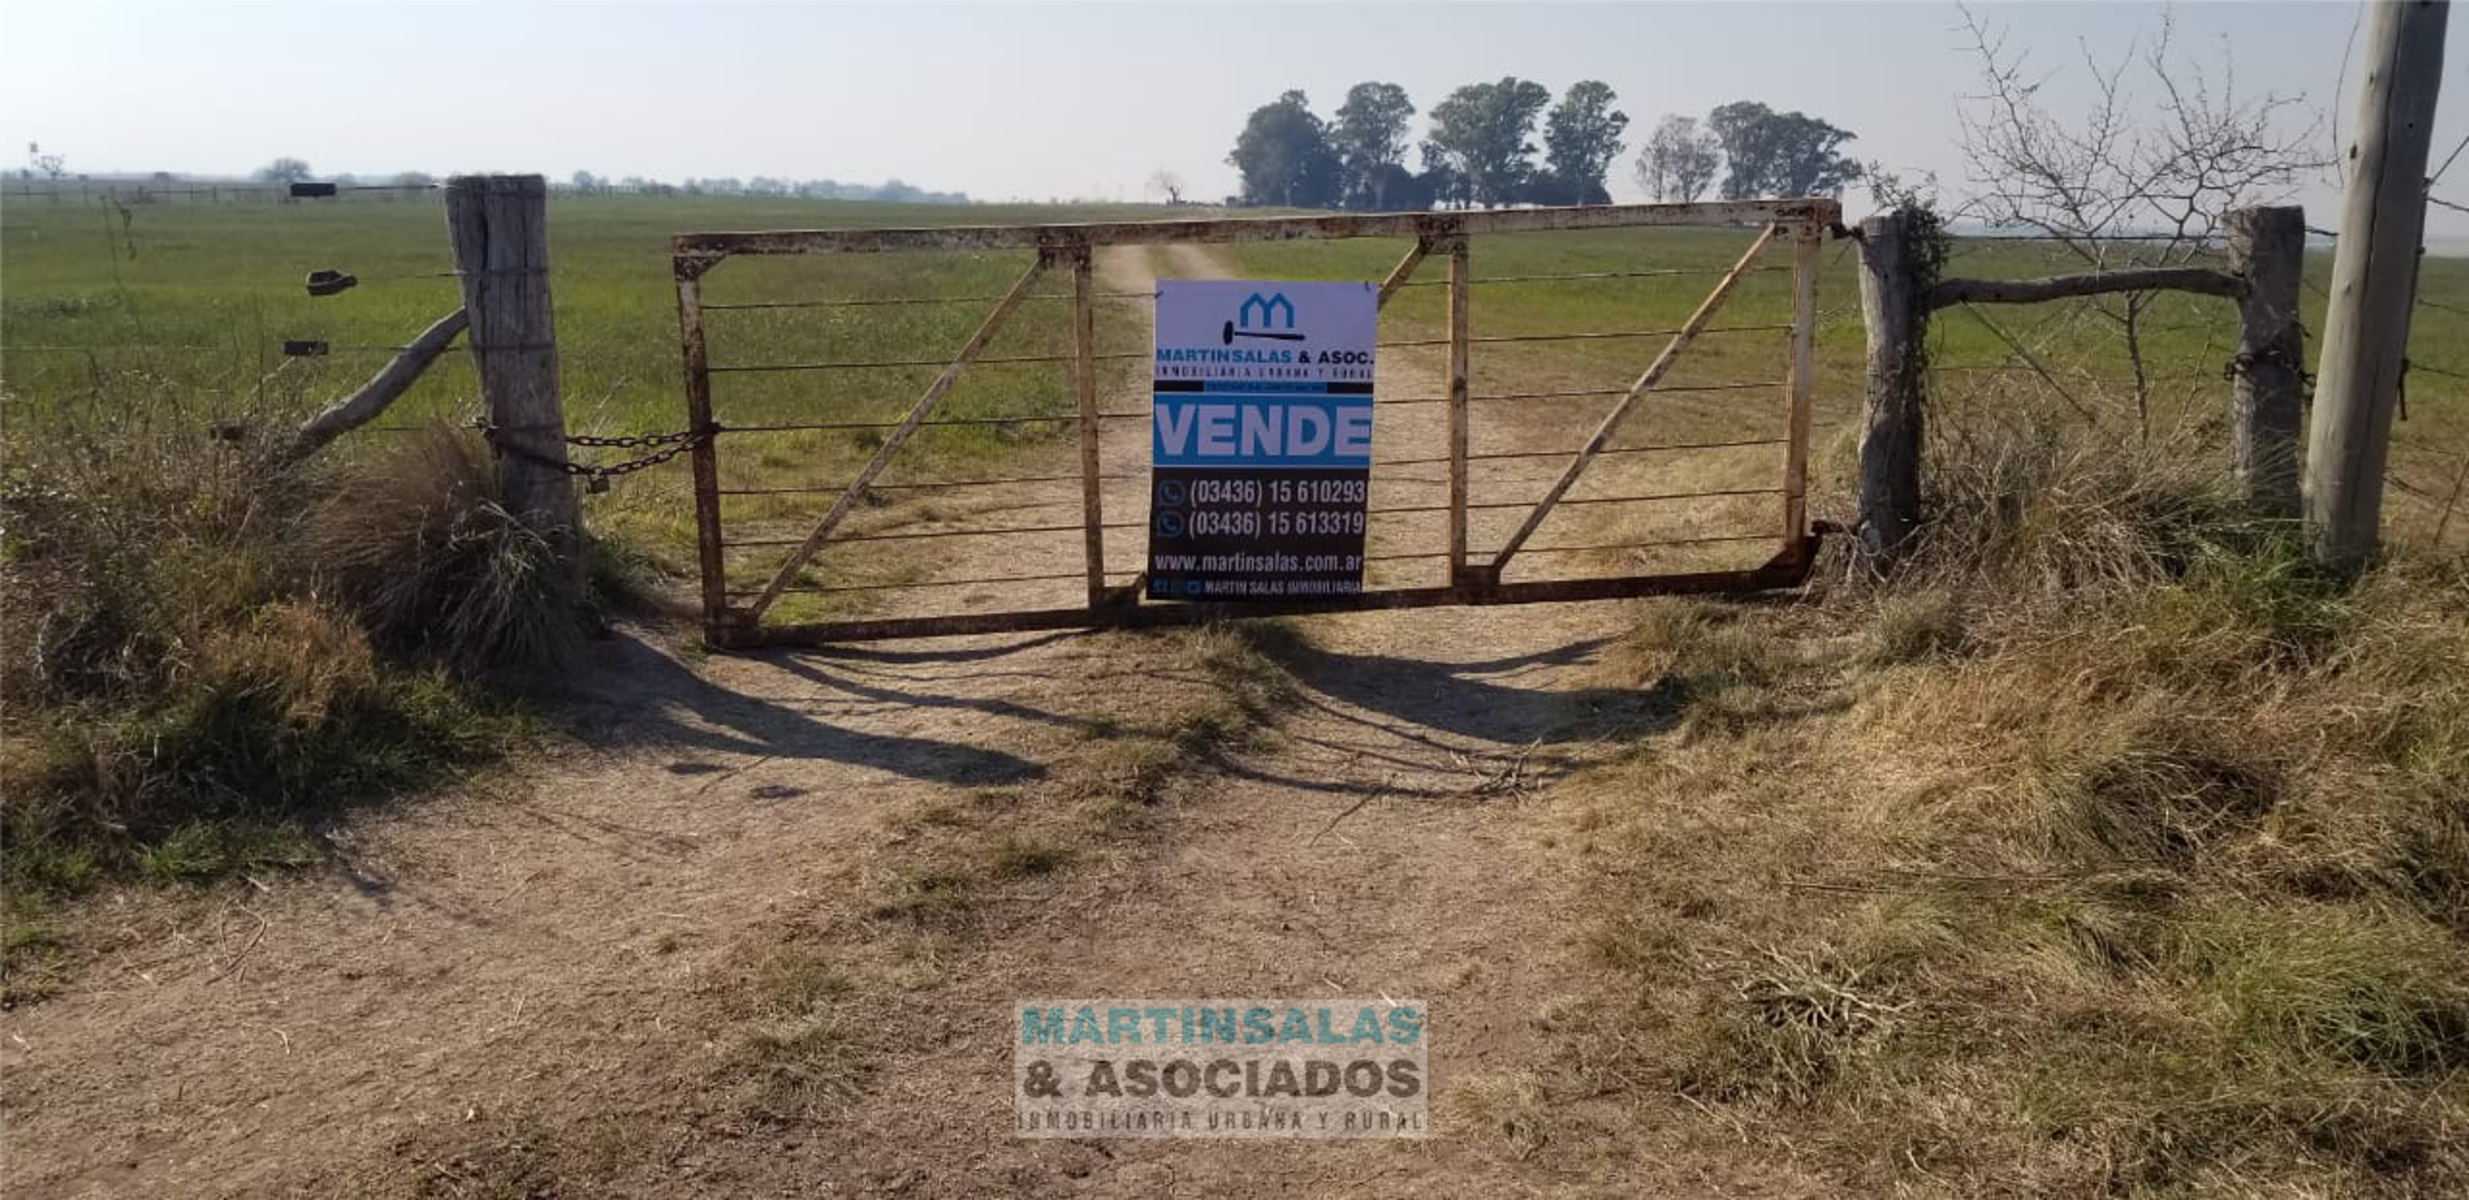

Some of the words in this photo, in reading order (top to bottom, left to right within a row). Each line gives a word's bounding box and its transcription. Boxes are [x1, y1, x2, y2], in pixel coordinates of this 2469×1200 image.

[1157, 349, 1292, 364] MARTINSALAS
[1298, 351, 1311, 364] &
[1317, 351, 1374, 365] ASOC.
[1155, 404, 1372, 457] VENDE
[1190, 479, 1263, 507] (03436)
[1269, 480, 1291, 503] 15
[1297, 479, 1365, 503] 610293
[1189, 511, 1261, 539] (03436)
[1268, 511, 1290, 535] 15
[1295, 511, 1364, 535] 613319
[1155, 551, 1363, 573] www.martinsalas.com.ar
[1205, 580, 1246, 595] MARTIN
[1249, 580, 1284, 595] SALAS
[1287, 579, 1362, 595] INMOBILIARIA
